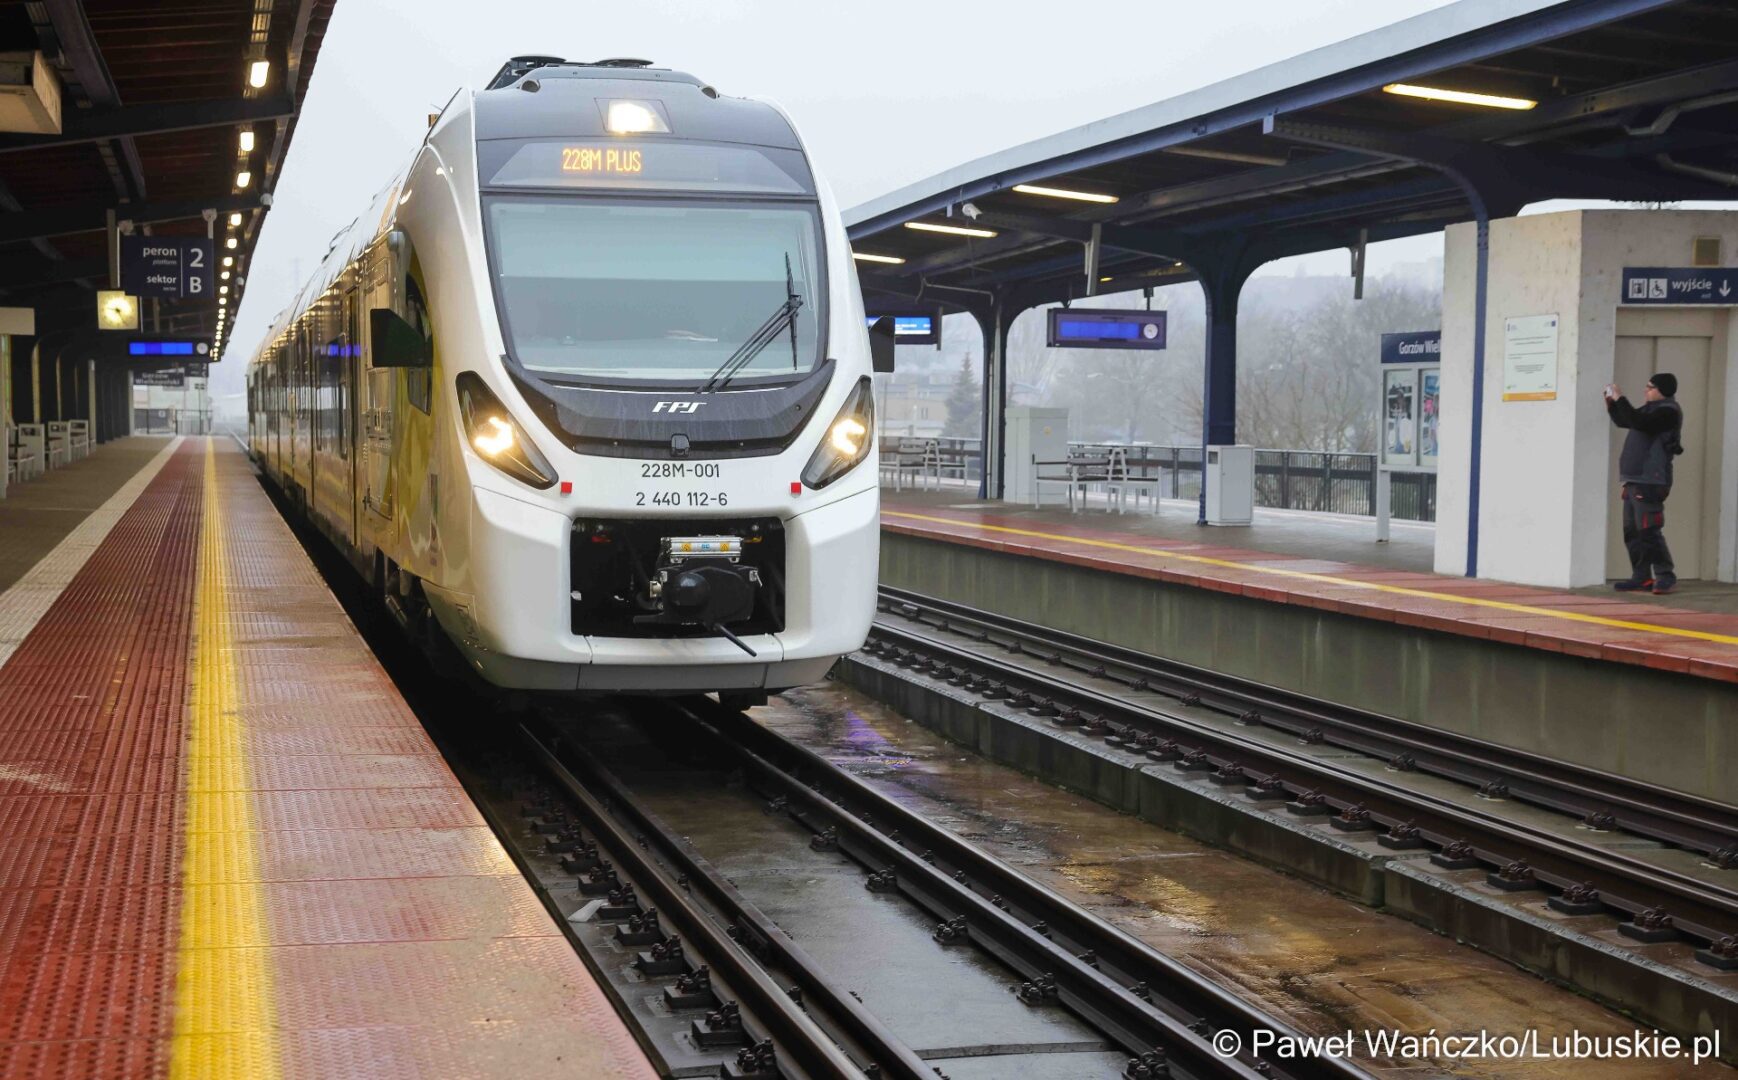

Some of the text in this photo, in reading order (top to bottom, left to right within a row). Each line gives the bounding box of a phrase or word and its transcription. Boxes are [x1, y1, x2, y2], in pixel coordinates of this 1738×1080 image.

[562, 148, 642, 172] 228M PLUS
[143, 247, 177, 258] peron
[189, 248, 204, 268] 2
[146, 274, 177, 284] sektor
[189, 276, 202, 294] B
[1671, 278, 1713, 293] wyjście
[1398, 340, 1424, 355] Gorzów
[652, 401, 708, 414] FPS
[641, 463, 720, 478] 228M-001
[636, 491, 728, 506] 2 440 112-6
